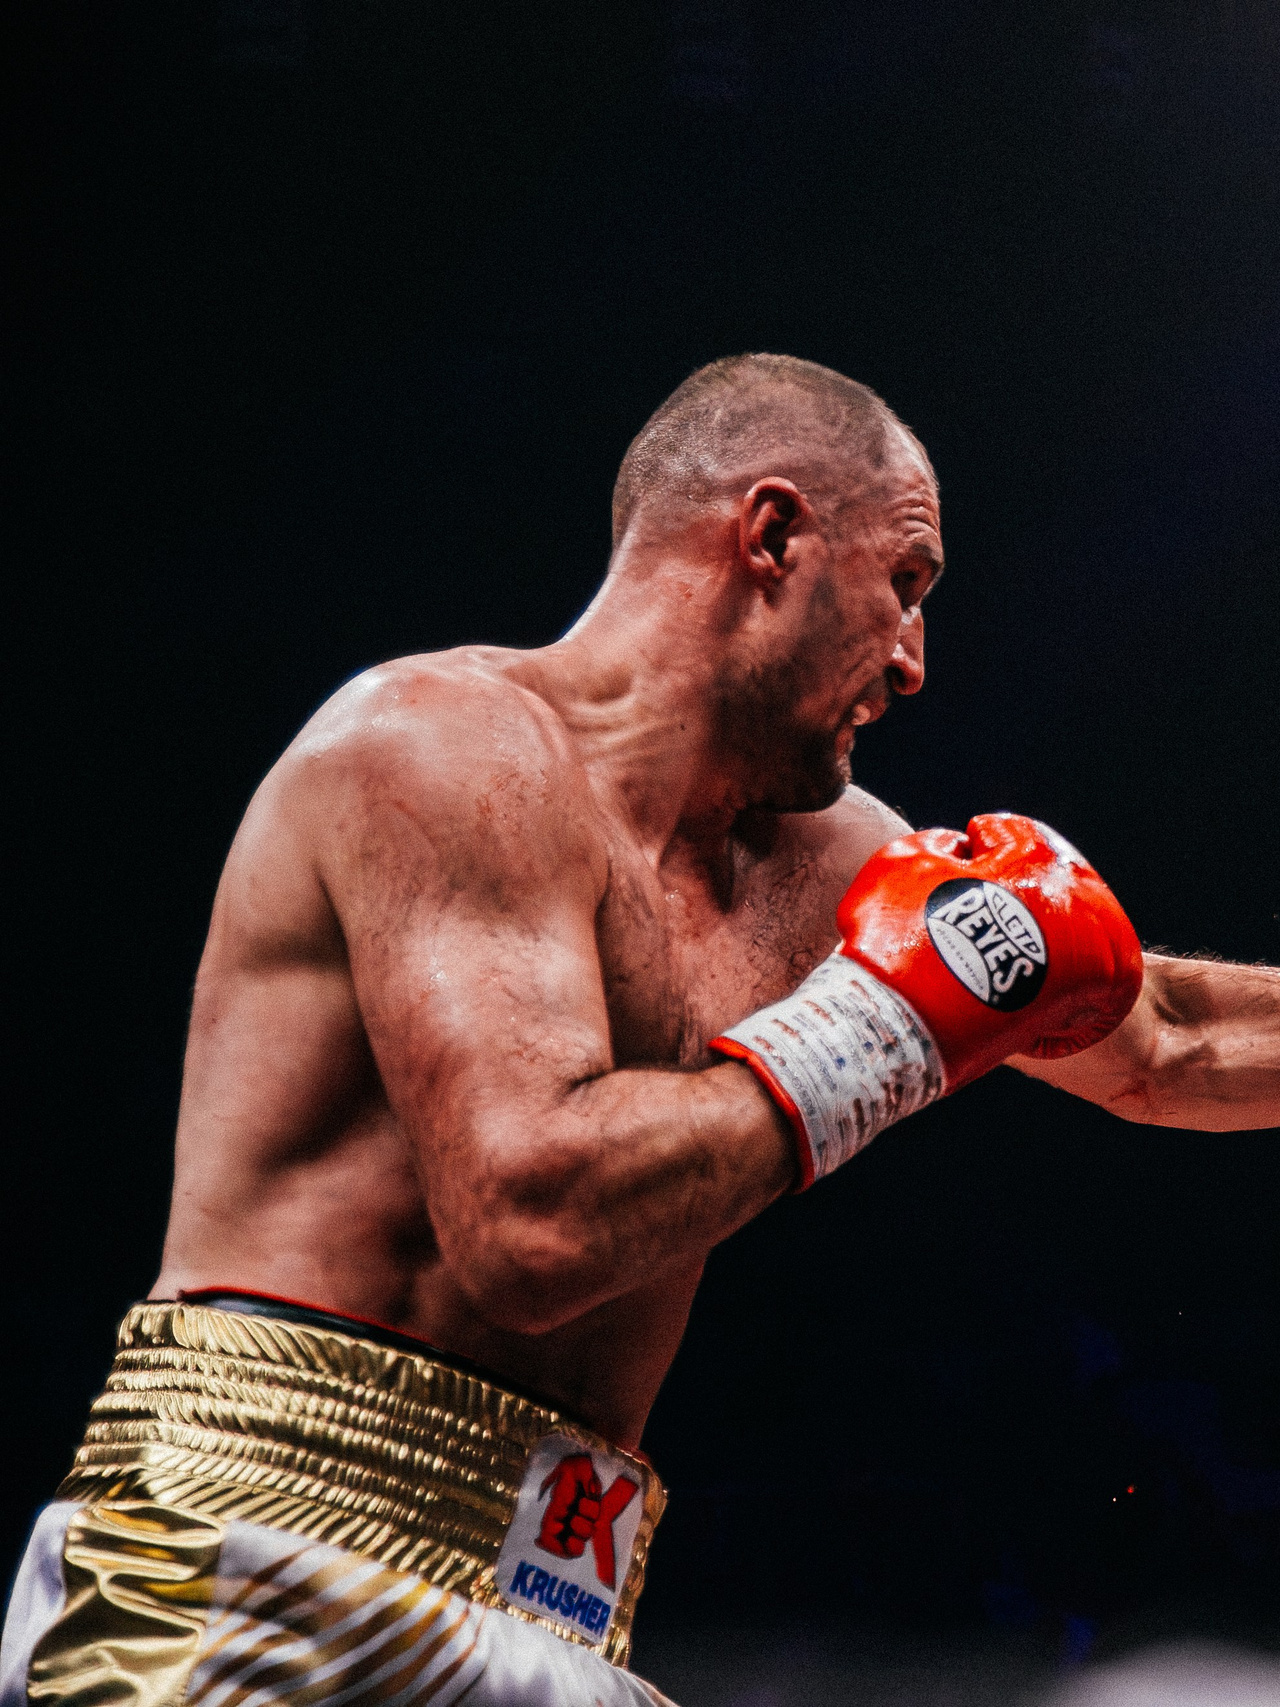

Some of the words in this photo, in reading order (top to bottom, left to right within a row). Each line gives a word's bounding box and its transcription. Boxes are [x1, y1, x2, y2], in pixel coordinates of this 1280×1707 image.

[930, 887, 1035, 993] REYES
[991, 892, 1042, 955] CLETO
[510, 1559, 612, 1638] KRUSHER
